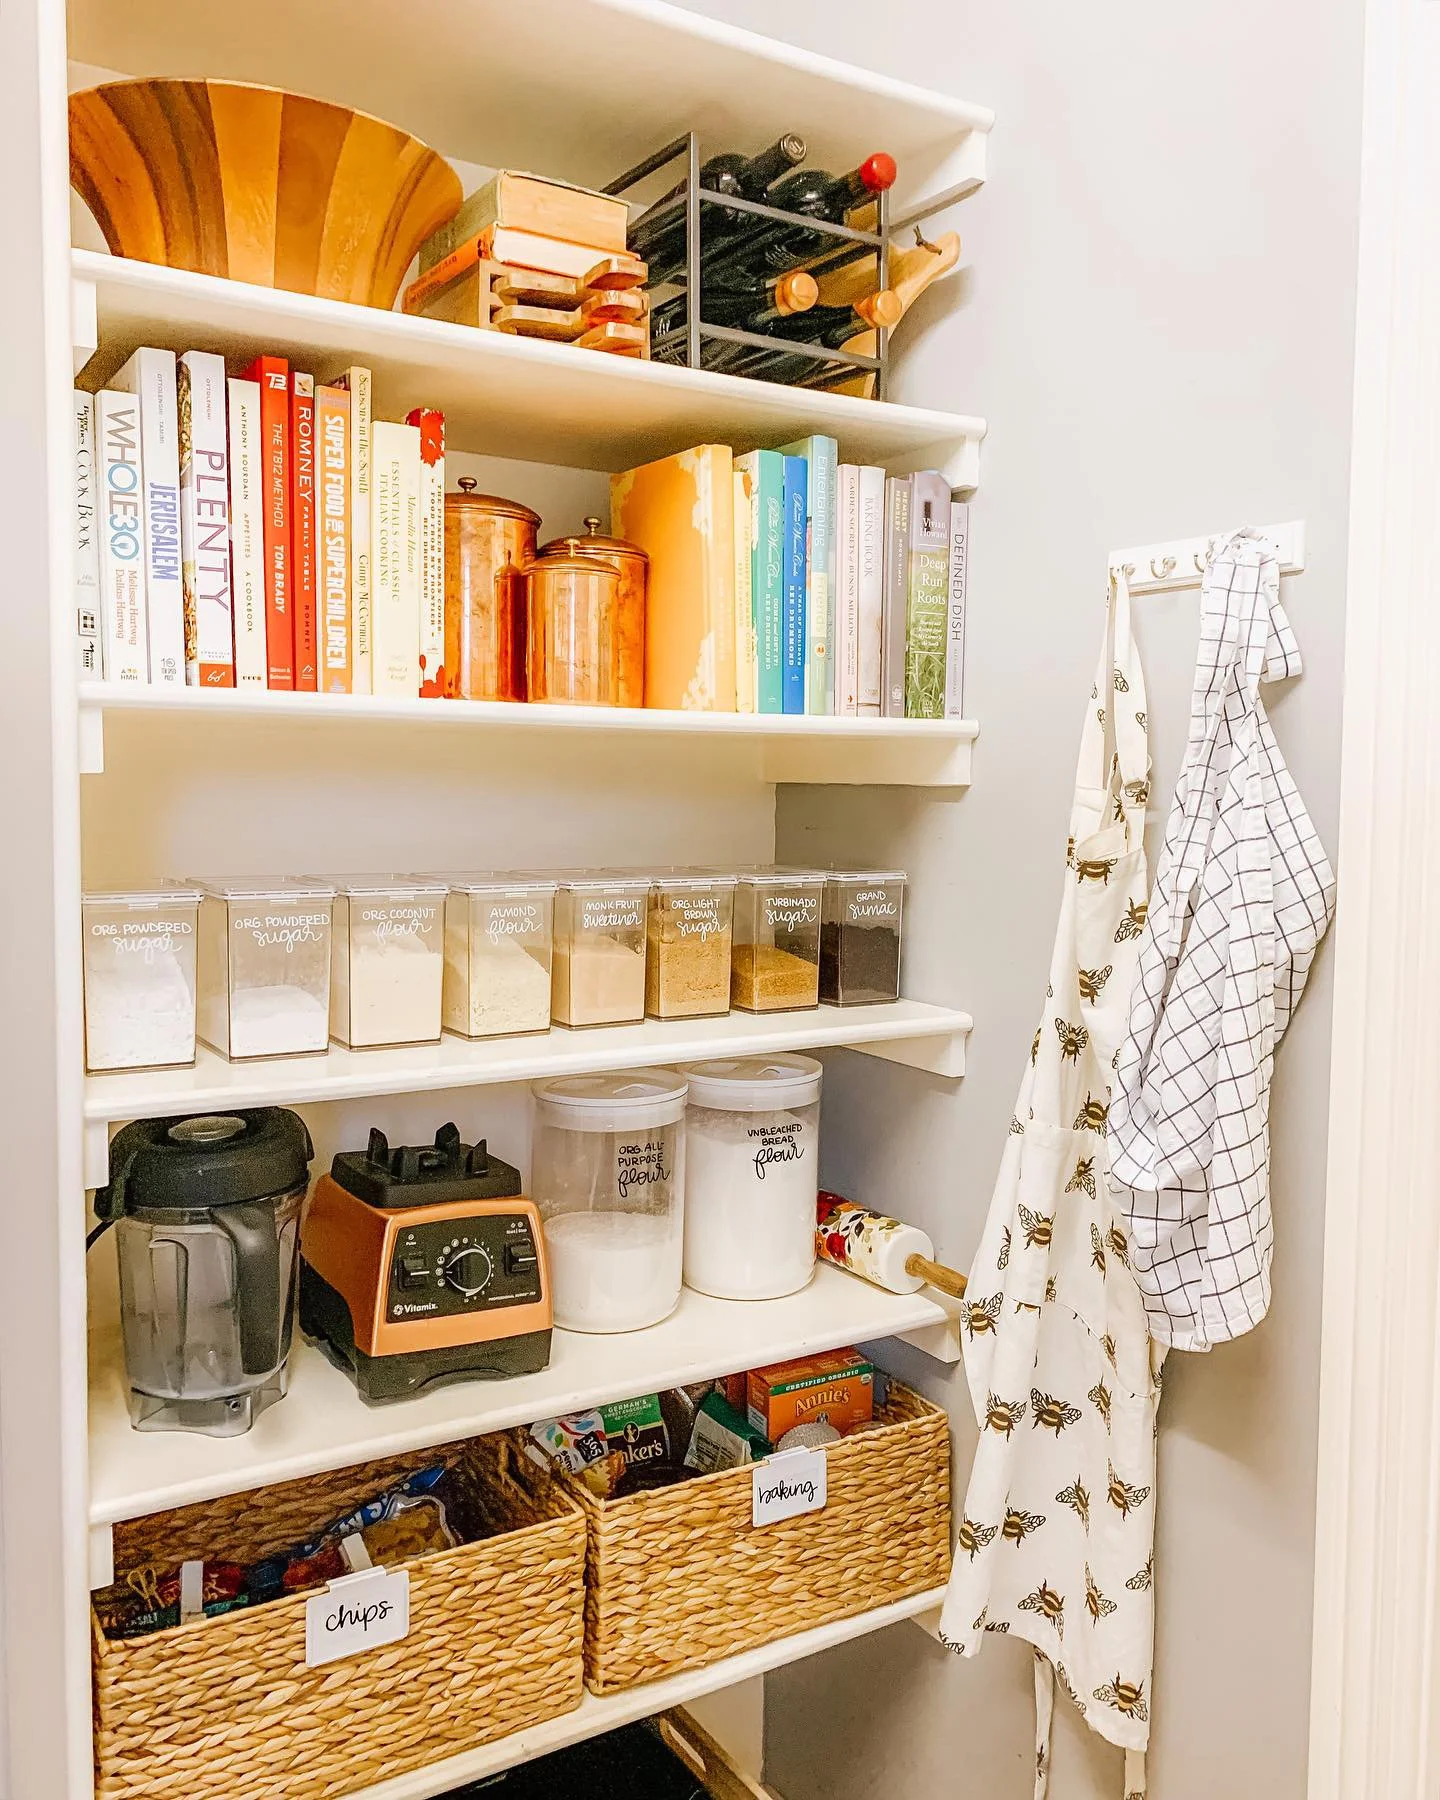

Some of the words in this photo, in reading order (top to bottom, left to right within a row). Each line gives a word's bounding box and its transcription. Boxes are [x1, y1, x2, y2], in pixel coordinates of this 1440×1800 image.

[240, 404, 248, 449] ANTHONY
[272, 423, 284, 446] THE
[324, 414, 345, 469] SUPER
[298, 406, 312, 503] ROMNEY
[106, 408, 140, 560] WHOLE30
[358, 461, 369, 494] South
[273, 478, 284, 528] METHOD
[324, 472, 345, 517] FOOD
[380, 473, 388, 524] ITALIAN
[391, 461, 400, 537] ESSENTIALS
[150, 482, 179, 582] JERUSALEM
[196, 449, 229, 611] PLENTY
[864, 496, 873, 541] BAKING
[243, 512, 251, 558] APPETITES
[274, 545, 284, 571] TOM
[358, 555, 369, 588] Ginny
[380, 528, 388, 587] COOKING
[864, 545, 873, 577] BOOK
[919, 554, 946, 574] Deep
[953, 533, 965, 600] DEFINED
[115, 569, 125, 600] Dallas
[128, 570, 138, 605] Melissa
[391, 551, 401, 602] CLASSIC
[922, 574, 944, 589] Run
[245, 581, 254, 633] COOKBOOK
[274, 573, 285, 614] BRADY
[325, 535, 347, 669] SUPERCHILDREN
[917, 590, 946, 606] Roots
[115, 601, 126, 640] Hartwig
[128, 608, 139, 646] Hartwig
[359, 591, 369, 656] McCormack
[951, 604, 962, 640] DISH
[490, 906, 537, 918] ALMOND
[585, 901, 615, 911] MONK
[615, 899, 642, 910] FRUIT
[671, 900, 693, 910] ORG.
[693, 898, 721, 909] LIGHT
[765, 897, 817, 908] TURBINADO
[849, 902, 897, 920] sumac
[856, 890, 886, 903] GRAND
[235, 917, 264, 929] ORG.
[265, 914, 330, 928] POWDERED
[389, 907, 436, 919] COCONUT
[583, 911, 643, 928] sweetener
[684, 909, 717, 920] BROWN
[765, 908, 817, 932] sugar
[92, 924, 121, 936] ORG.
[123, 922, 193, 935] POWDERED
[252, 926, 323, 953] sugar
[373, 919, 433, 945] flour
[486, 917, 543, 945] flour
[676, 918, 728, 943] sugar
[112, 933, 183, 964] sugar
[747, 1123, 803, 1137] UNBLEACHED
[761, 1135, 794, 1146] BREAD
[617, 1152, 664, 1167] PURPOSE
[618, 1145, 643, 1155] ORG.
[752, 1142, 805, 1180] flour
[617, 1162, 671, 1198] flour
[404, 1302, 437, 1314] Vitamix
[785, 1377, 826, 1391] CERTIFIED
[608, 1399, 647, 1413] GERMAN'S
[795, 1384, 852, 1417] Annie's
[583, 1436, 602, 1457] 365
[758, 1478, 818, 1504] baking
[325, 1599, 393, 1633] chips
